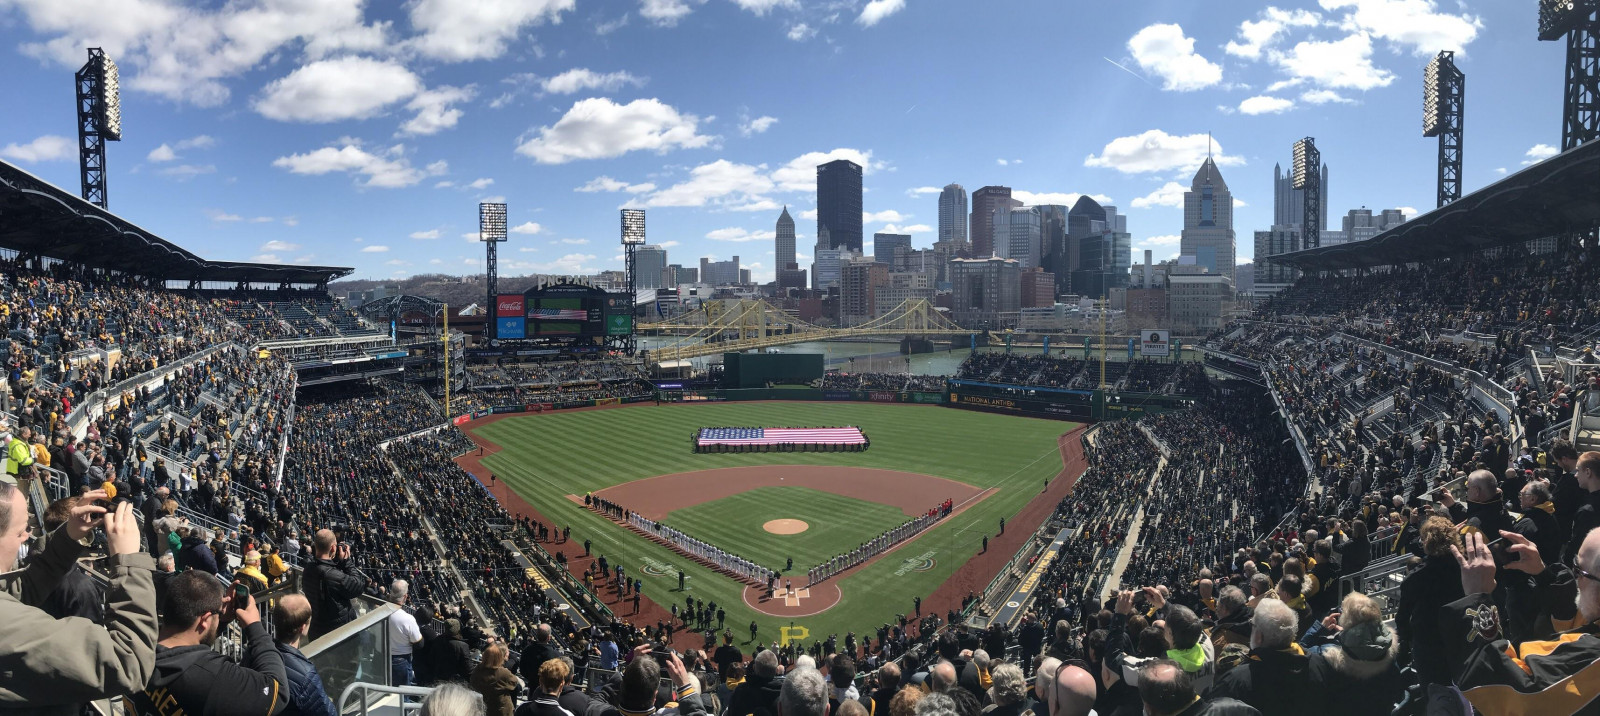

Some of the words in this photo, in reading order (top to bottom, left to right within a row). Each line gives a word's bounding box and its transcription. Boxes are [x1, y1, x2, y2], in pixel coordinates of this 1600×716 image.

[537, 274, 563, 291] PNC
[566, 274, 597, 290] PARK
[871, 392, 894, 401] xfinity
[964, 396, 990, 404] NATIONAL
[991, 399, 1015, 407] ANTHEM
